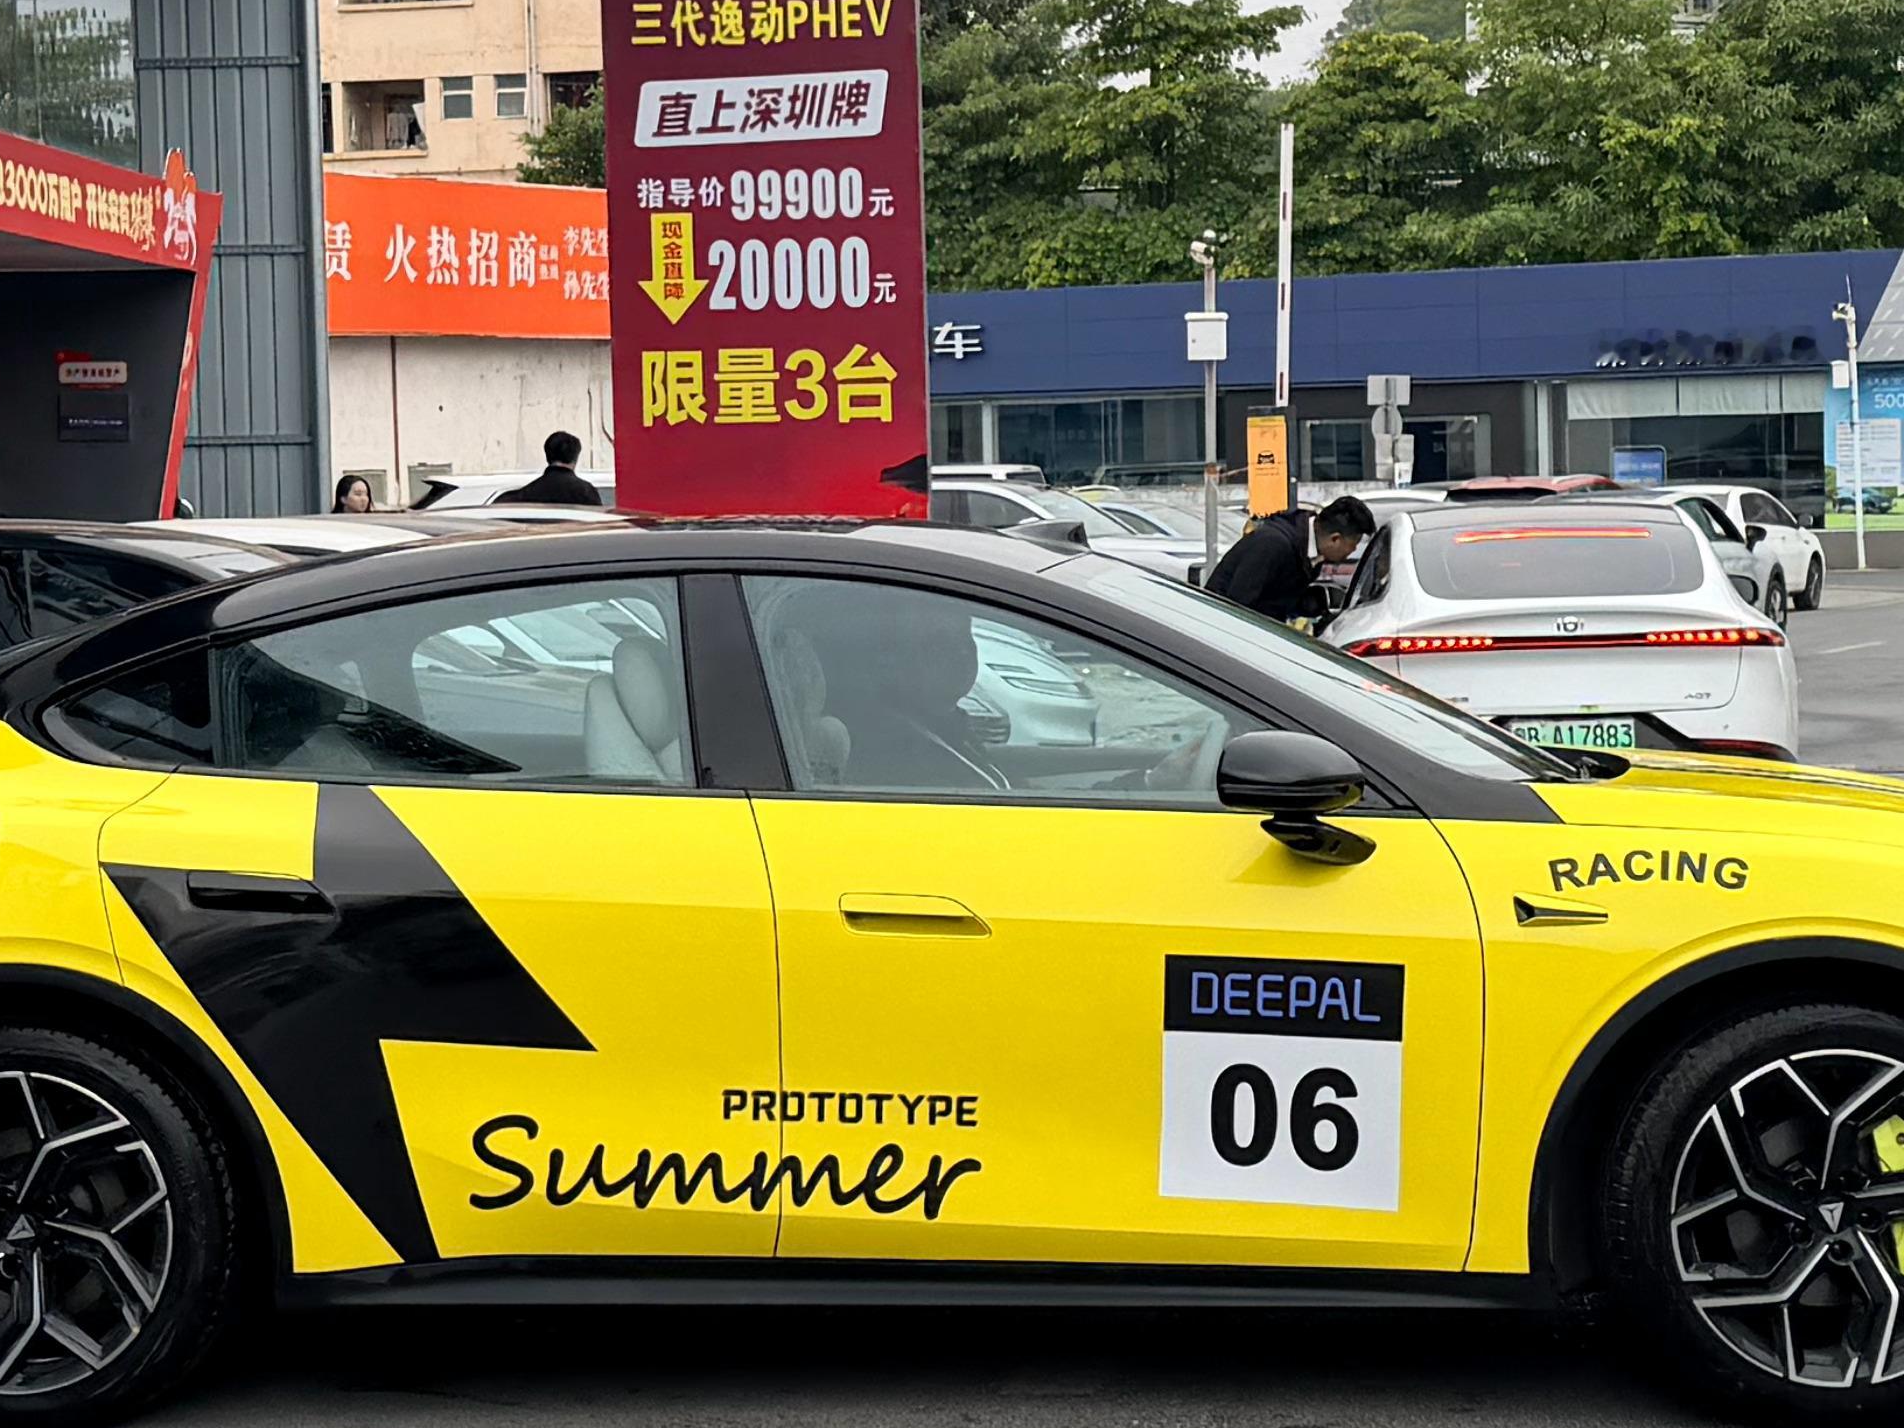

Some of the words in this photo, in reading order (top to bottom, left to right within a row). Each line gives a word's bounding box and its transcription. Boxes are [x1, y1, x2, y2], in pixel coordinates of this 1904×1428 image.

[651, 79, 872, 139] 直上深圳牌
[383, 223, 538, 289] 火热招商
[933, 321, 983, 359] 车
[641, 343, 898, 428] 限量3台
[1546, 847, 1751, 892] RACING
[1188, 971, 1382, 1024] DEEPAL
[720, 1087, 980, 1129] PROTOTYPE
[1207, 1063, 1360, 1172] 06
[467, 1113, 982, 1222] Summer
